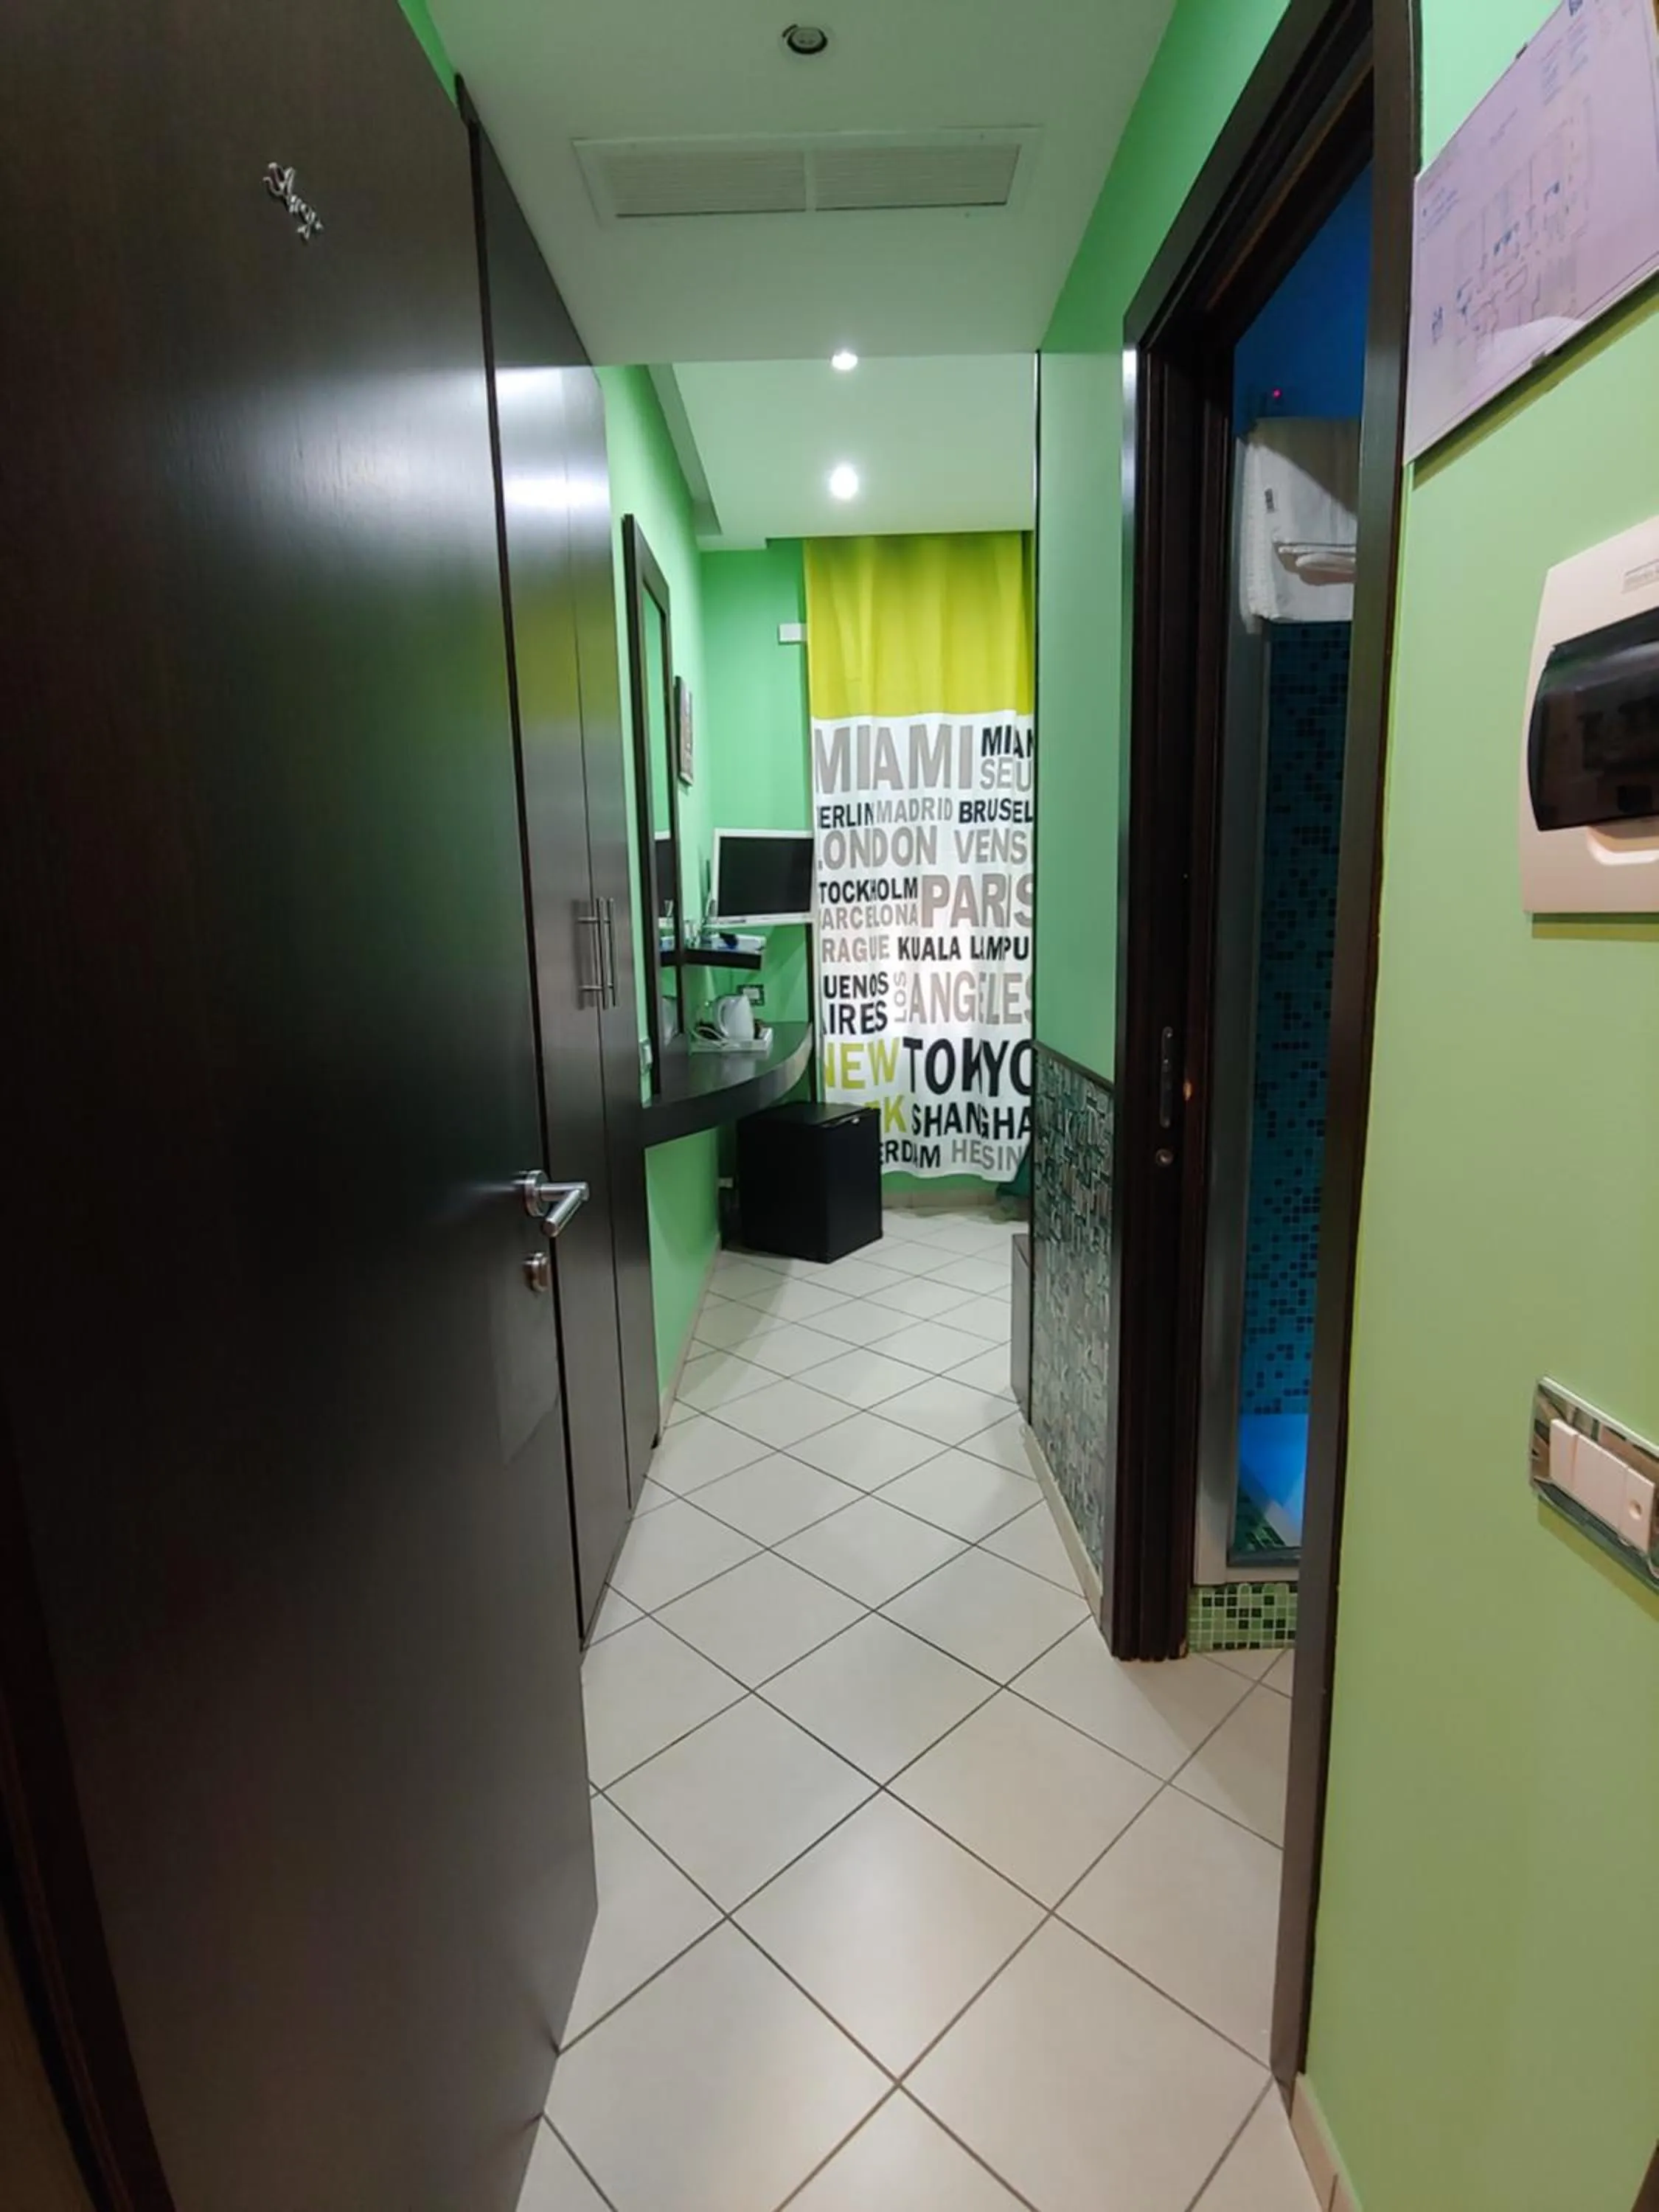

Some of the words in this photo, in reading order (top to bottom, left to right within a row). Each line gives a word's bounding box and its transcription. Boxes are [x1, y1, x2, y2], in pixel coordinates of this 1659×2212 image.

[814, 724, 974, 794] MIAMI
[817, 802, 874, 829] ERLIN
[876, 797, 953, 823] MADRID
[818, 824, 937, 871] ONDON
[818, 903, 919, 931] ARCELONA
[922, 872, 1033, 928] PARIS
[897, 936, 961, 961] KUALA
[893, 970, 908, 1023] LOS
[821, 1001, 888, 1034] IRES
[902, 1036, 1033, 1098] TOKYO
